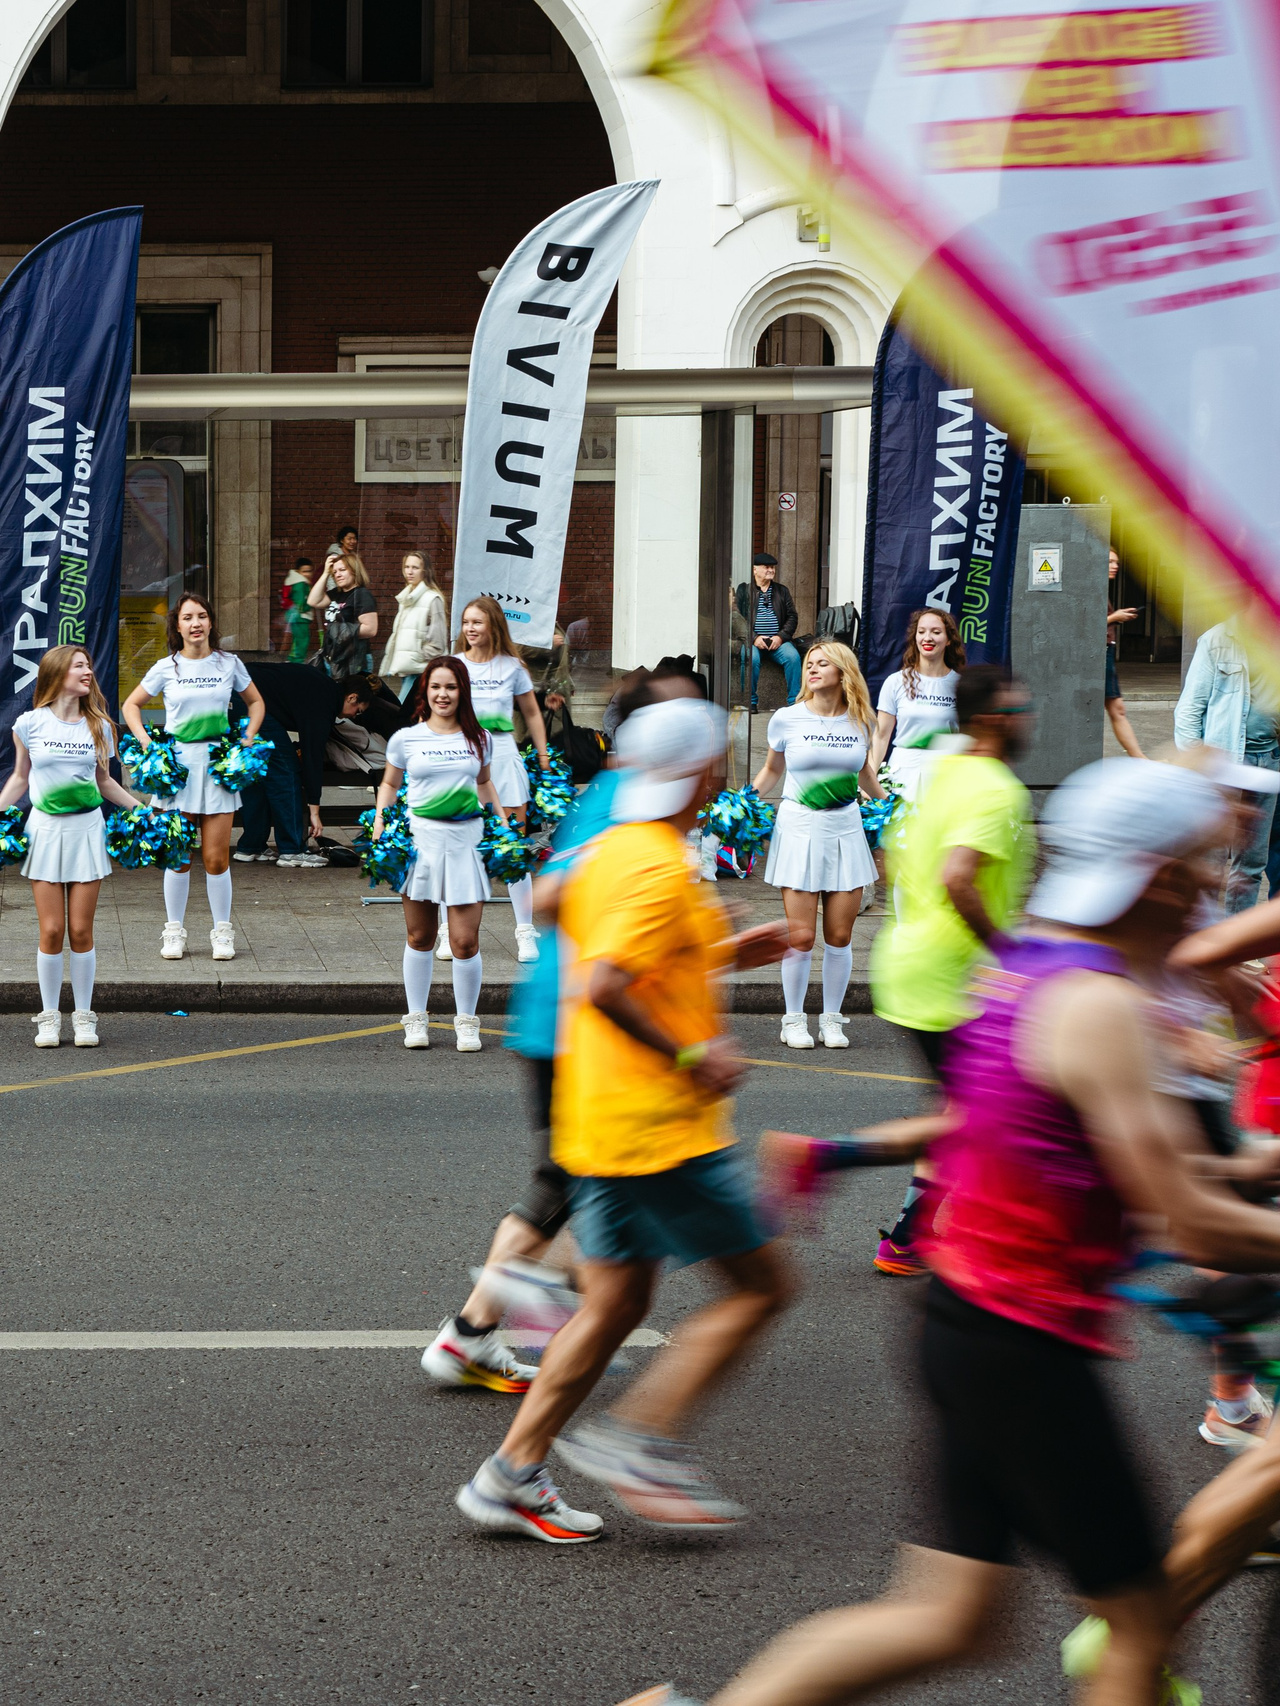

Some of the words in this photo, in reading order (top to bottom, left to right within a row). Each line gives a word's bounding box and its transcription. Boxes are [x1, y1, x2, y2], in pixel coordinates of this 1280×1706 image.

[486, 242, 595, 559] BIVIUM
[375, 438, 463, 463] ЦВЕТ
[925, 388, 974, 613] АЛХИМ
[12, 386, 65, 694] УРАЛХИМ
[504, 612, 521, 620] m.ru
[916, 694, 957, 703] РАЛХИМ
[43, 741, 93, 750] УРАЛХИМ
[803, 735, 859, 743] УРАЛХИМ
